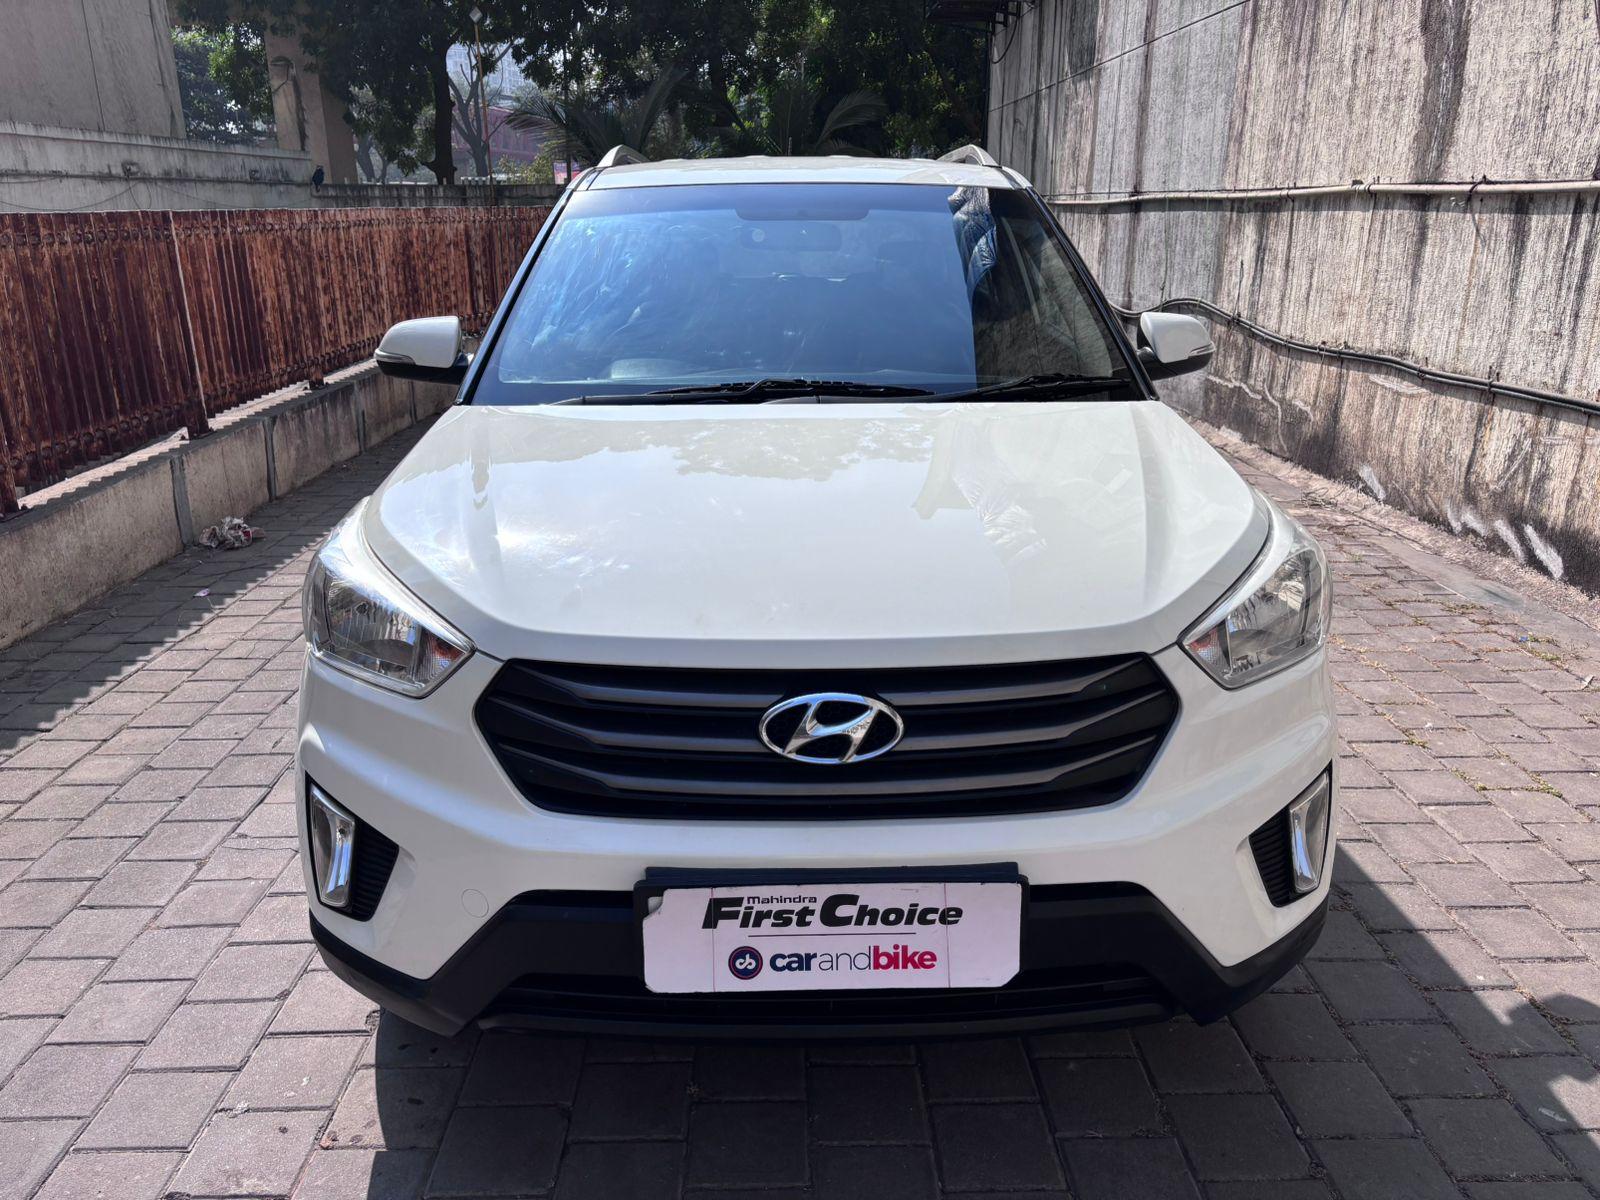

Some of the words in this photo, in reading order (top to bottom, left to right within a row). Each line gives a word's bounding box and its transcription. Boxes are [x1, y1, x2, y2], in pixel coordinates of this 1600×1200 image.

[701, 896, 816, 929] First
[819, 893, 964, 927] Choice
[747, 895, 817, 905] Mahindra
[769, 943, 938, 972] carandbike
